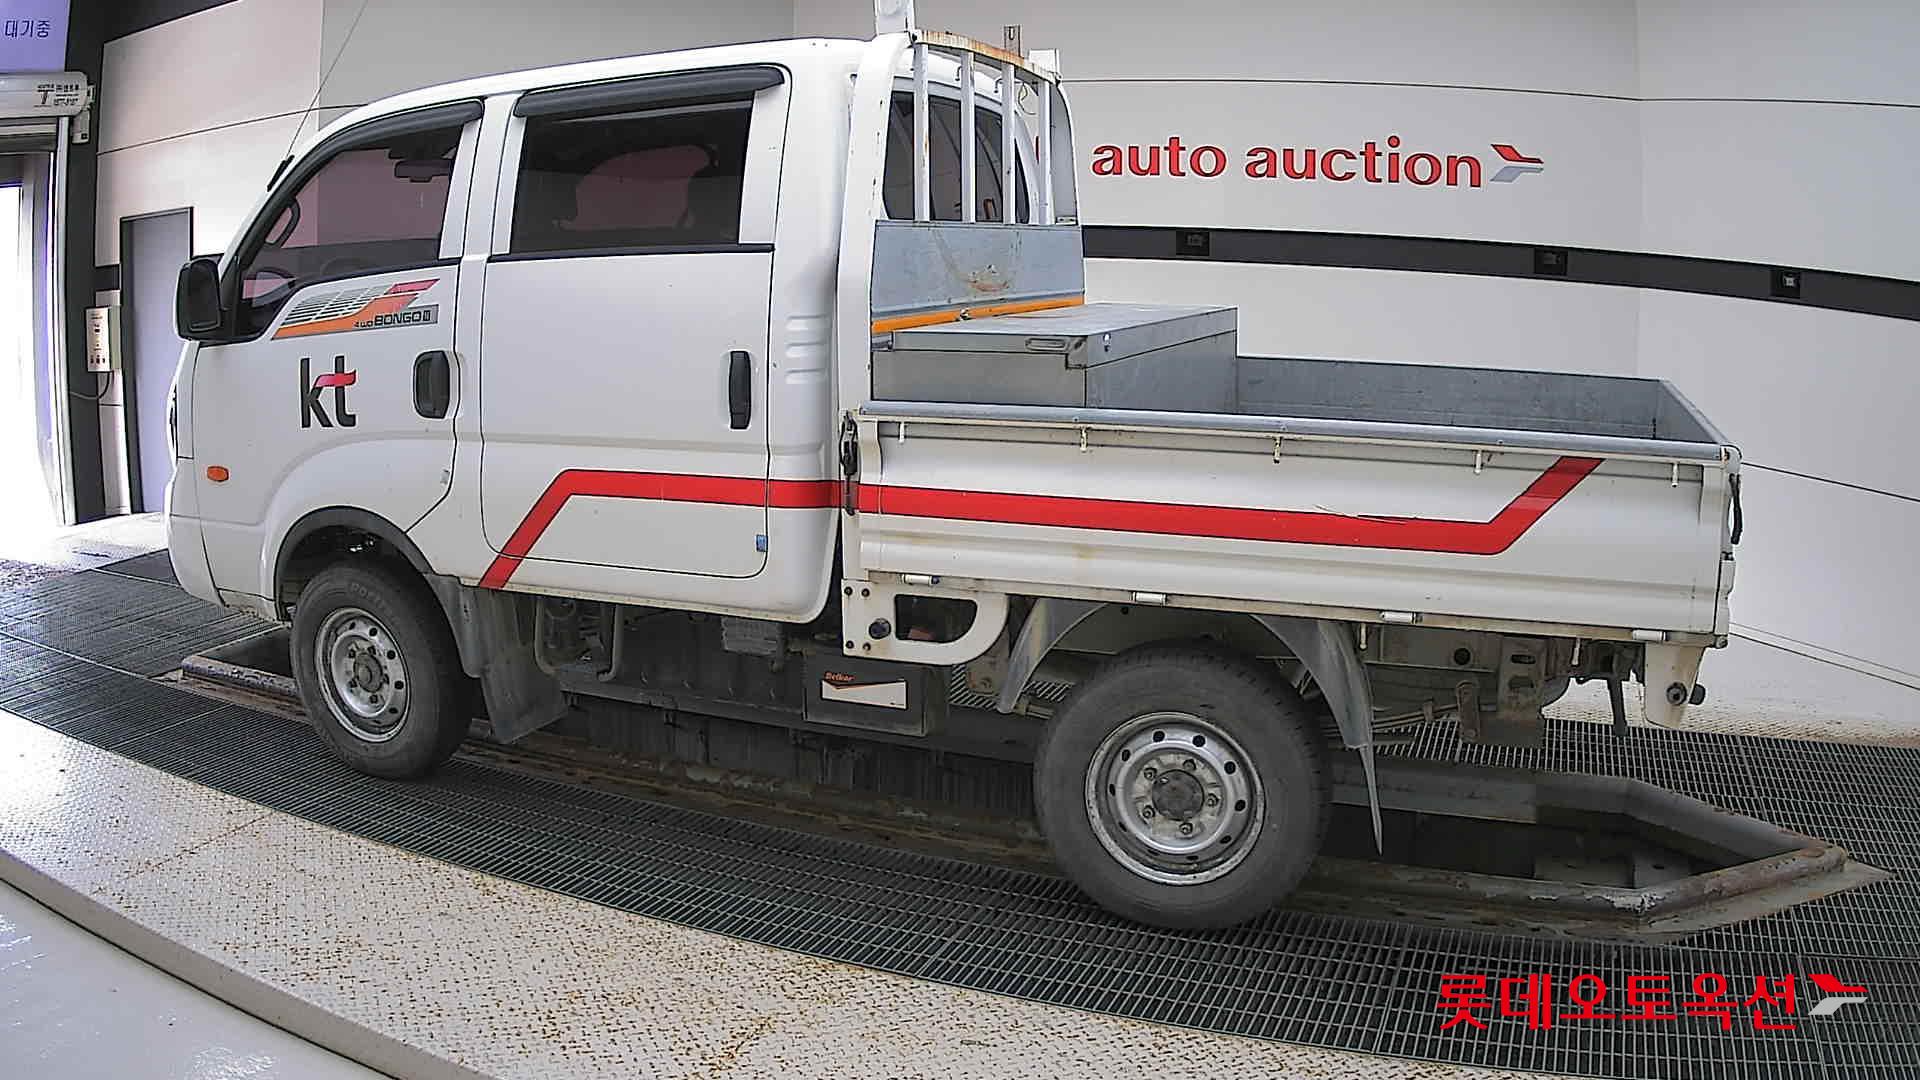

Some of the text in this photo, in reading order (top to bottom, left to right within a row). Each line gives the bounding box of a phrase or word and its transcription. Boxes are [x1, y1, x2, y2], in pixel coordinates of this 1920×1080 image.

[4, 20, 51, 38] 대기중
[1092, 137, 1227, 178] auto
[1245, 136, 1481, 188] auction
[374, 311, 421, 326] BONGO
[301, 355, 356, 428] kt
